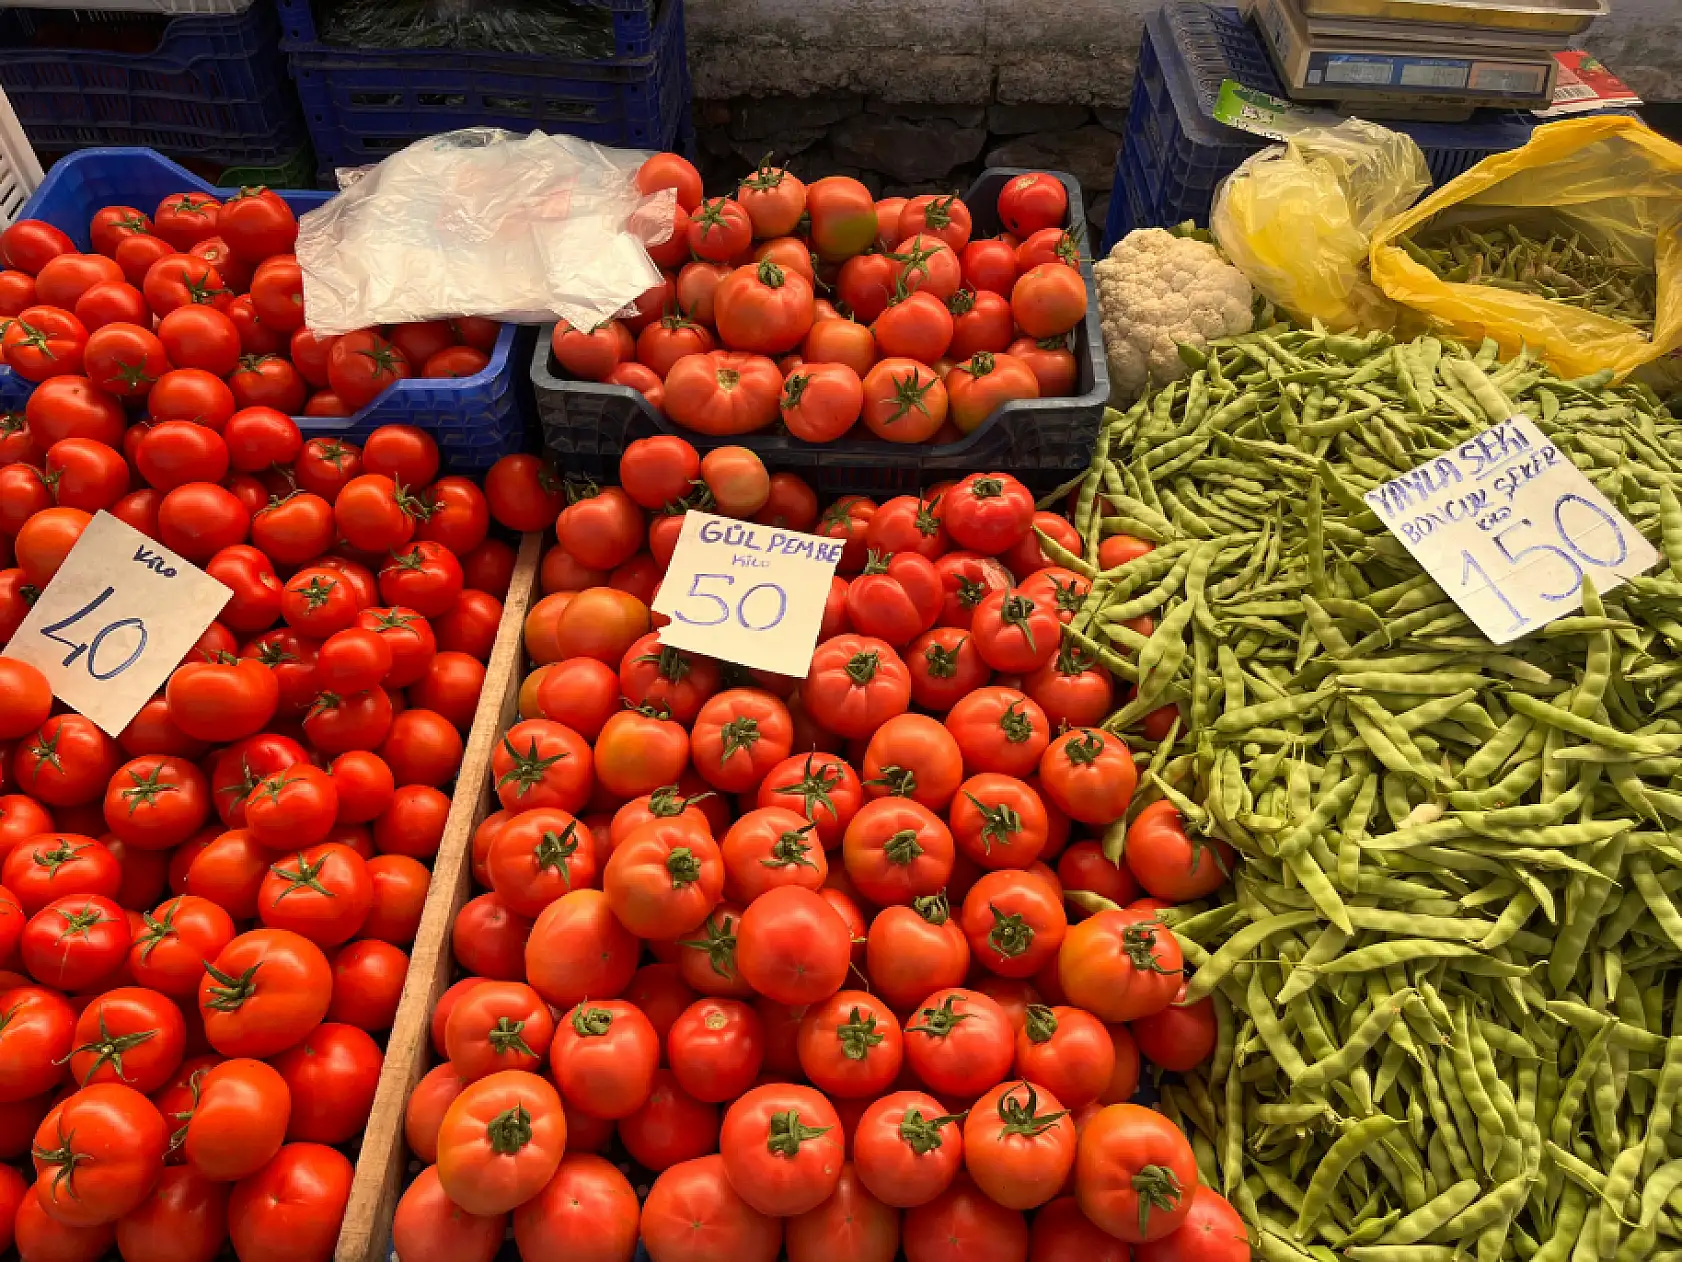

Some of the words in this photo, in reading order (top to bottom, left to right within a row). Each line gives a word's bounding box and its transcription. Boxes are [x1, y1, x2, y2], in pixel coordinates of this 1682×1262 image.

[1369, 457, 1463, 518] YAYLA
[1400, 489, 1495, 545] BONCUK
[699, 520, 763, 551] GÜL
[766, 533, 842, 563] PEMBE
[1461, 493, 1627, 633] 150
[674, 573, 788, 632] 50
[40, 586, 148, 681] 40
